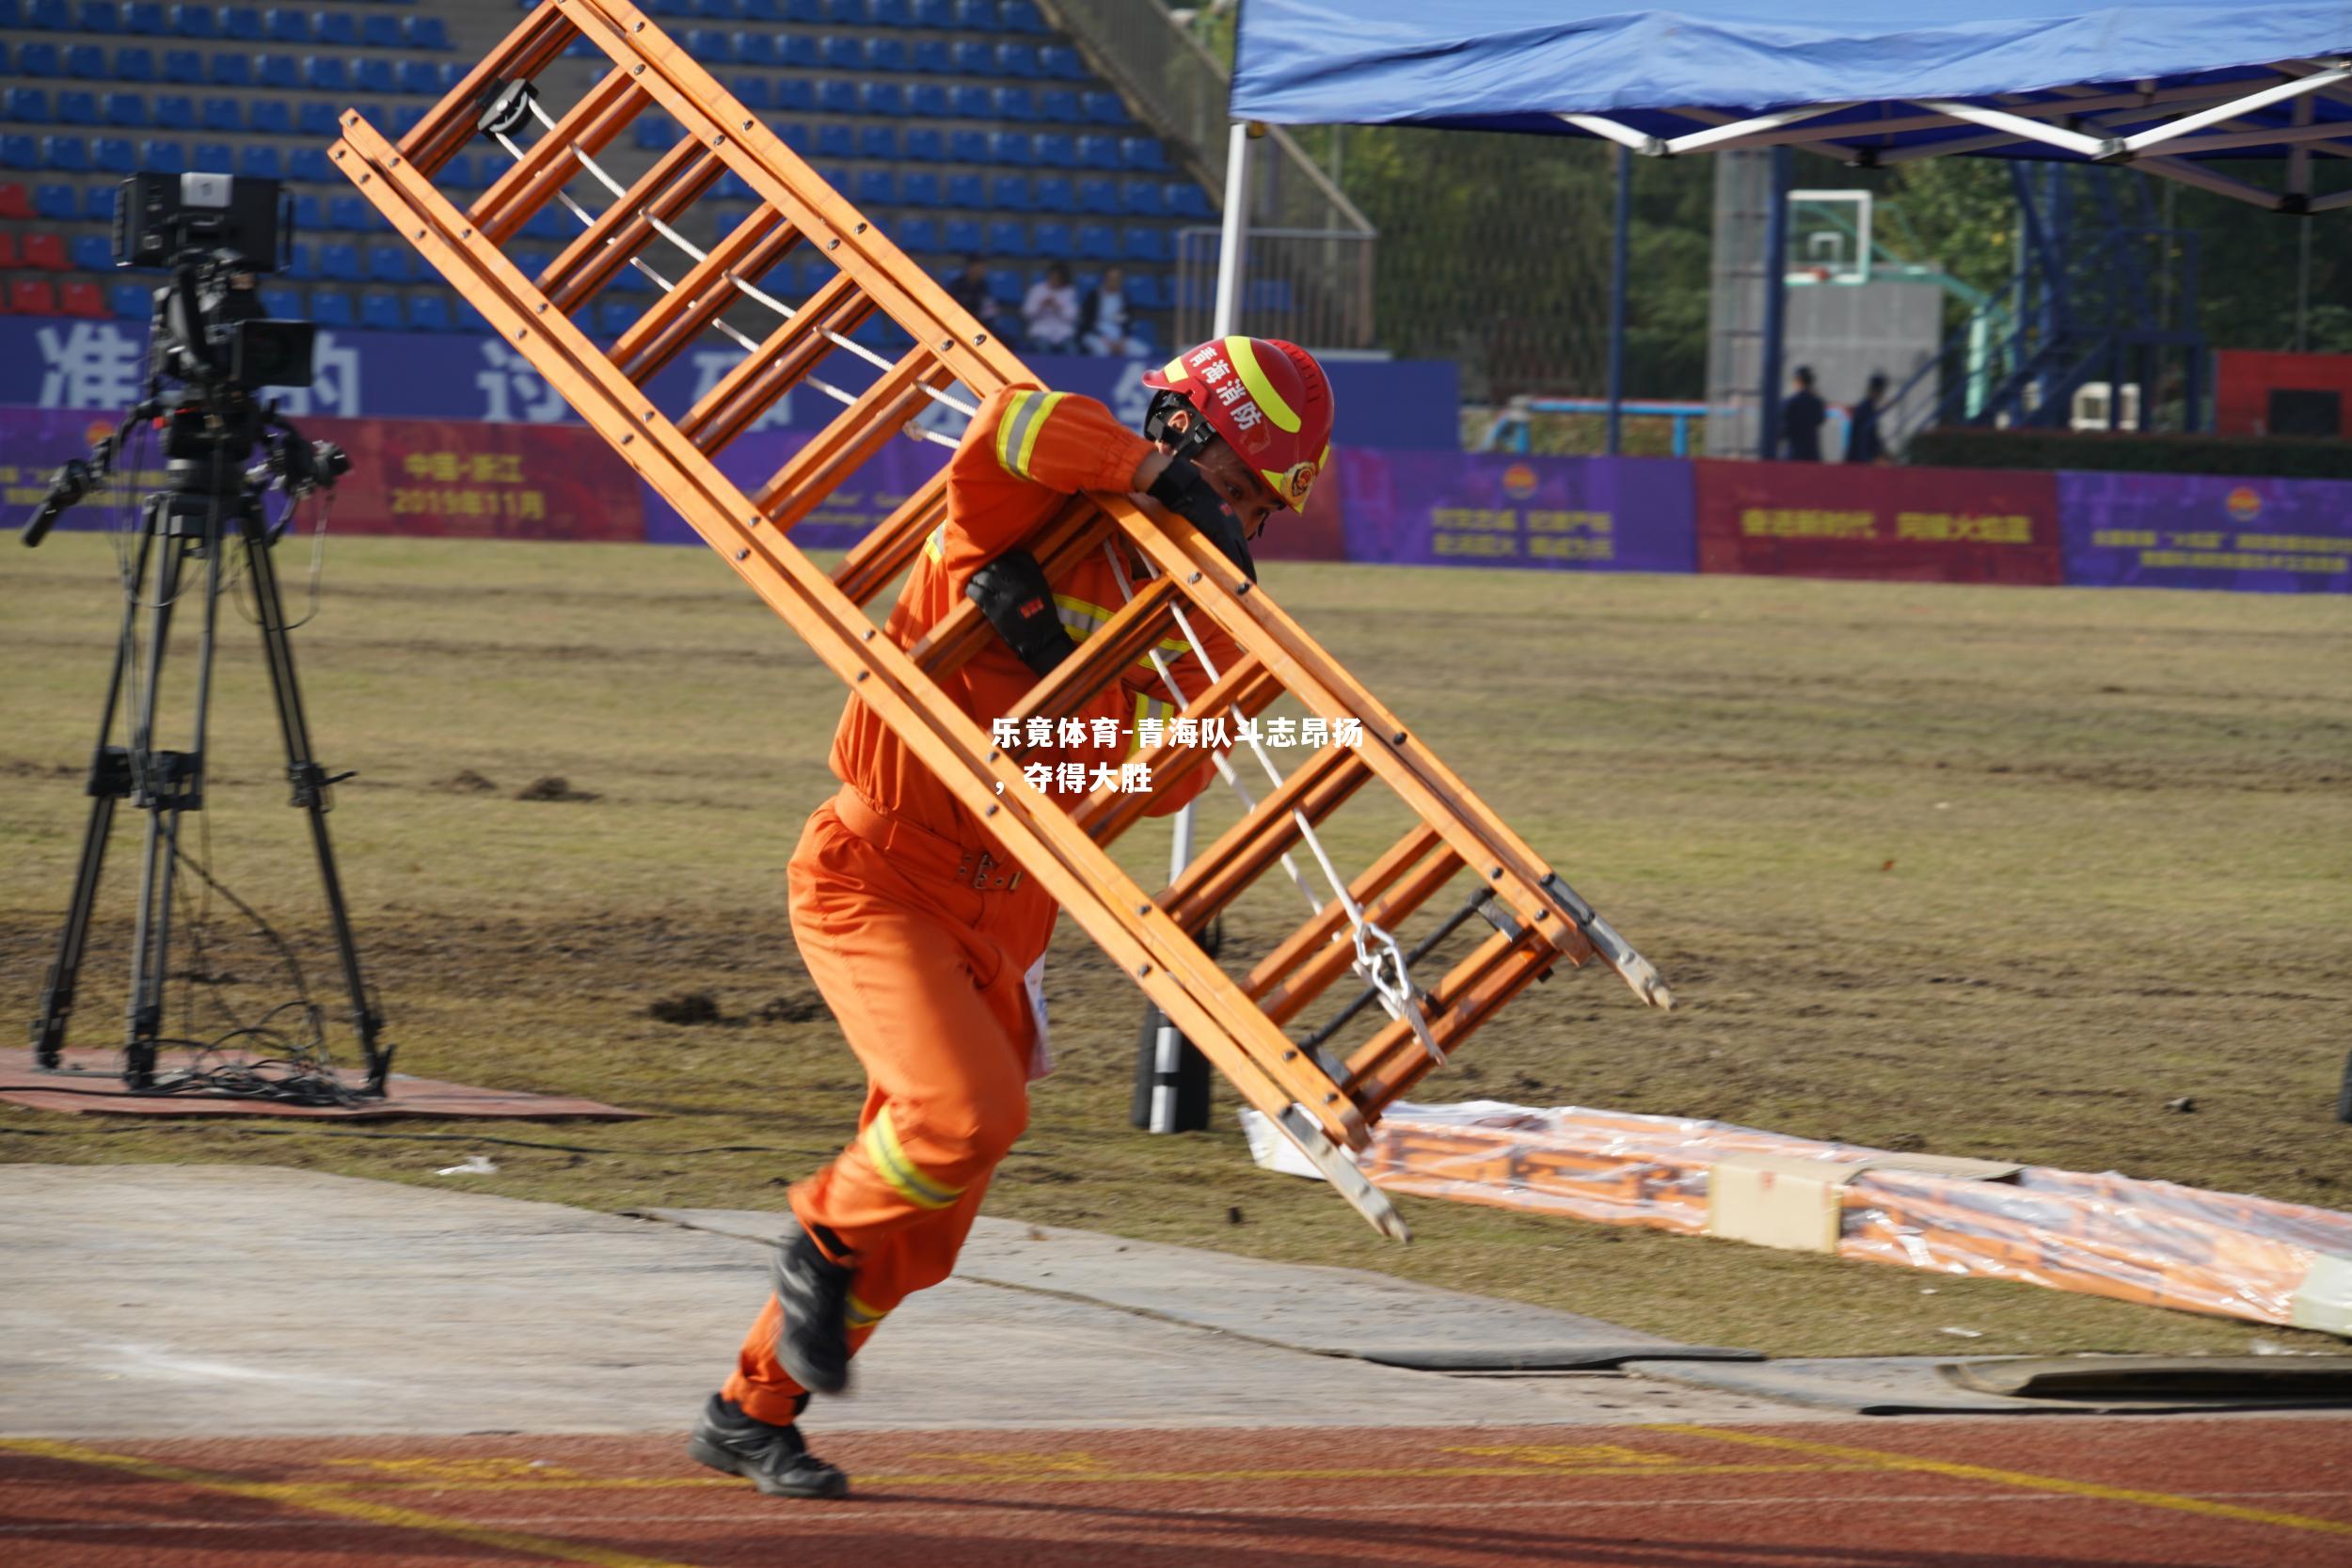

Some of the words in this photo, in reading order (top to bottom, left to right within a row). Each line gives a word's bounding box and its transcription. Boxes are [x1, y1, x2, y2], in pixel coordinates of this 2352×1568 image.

[37, 321, 139, 409] 准
[1189, 346, 1263, 431] 青海消防
[391, 488, 545, 520] 2019年11月
